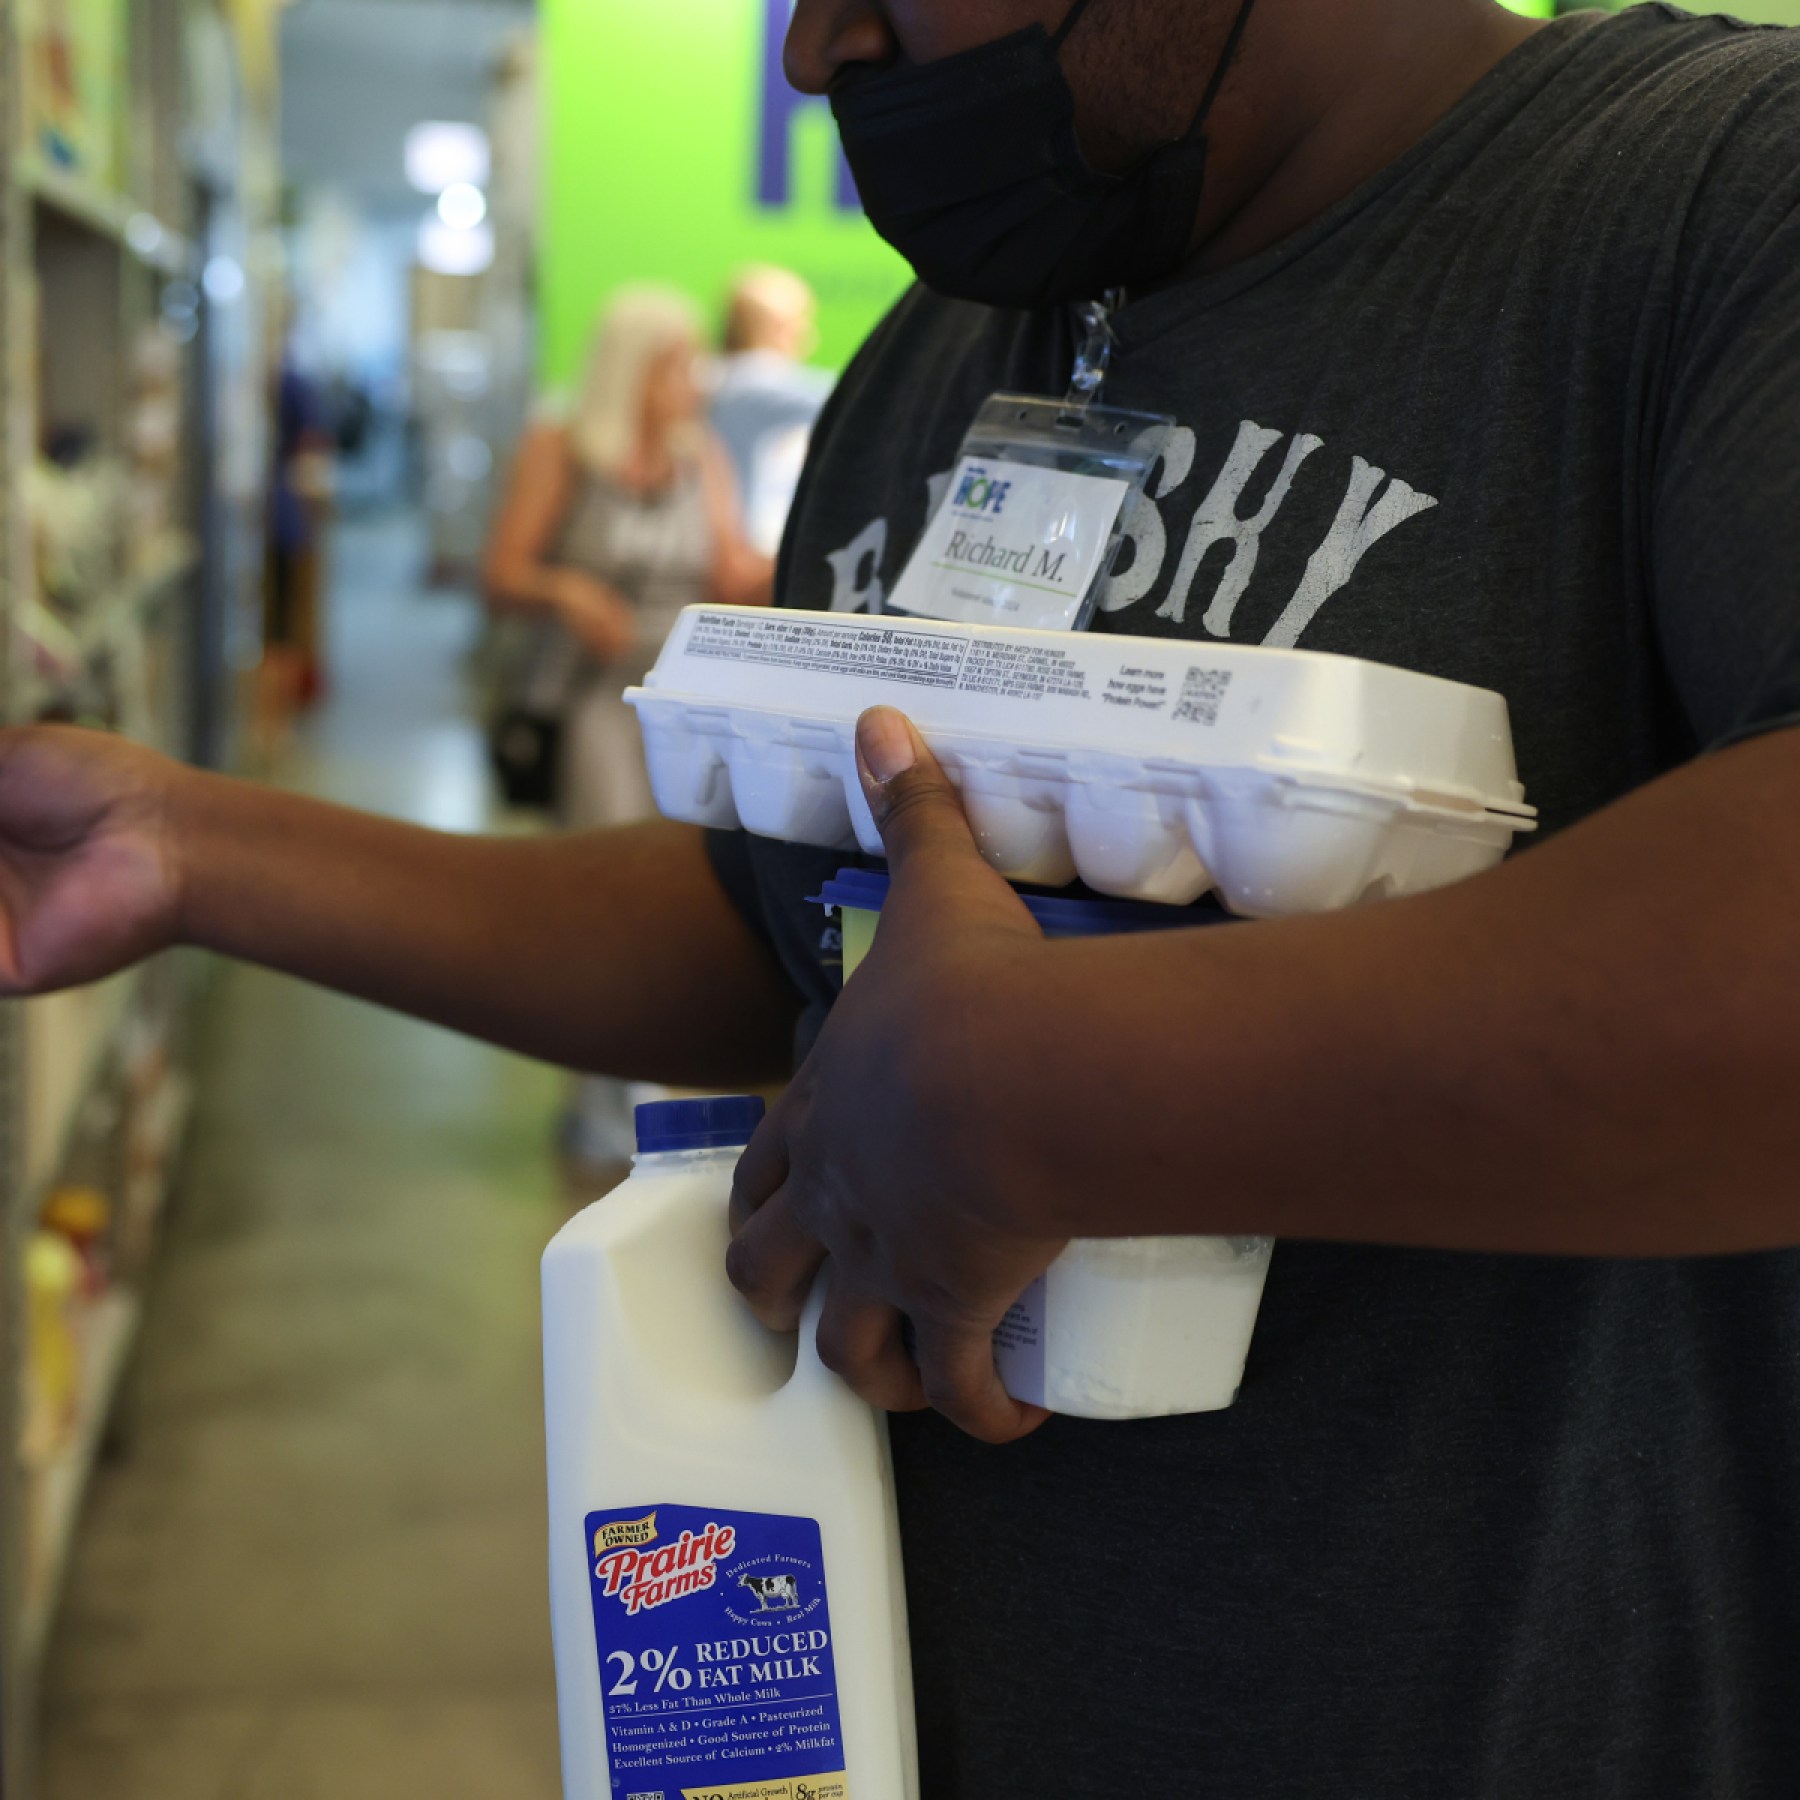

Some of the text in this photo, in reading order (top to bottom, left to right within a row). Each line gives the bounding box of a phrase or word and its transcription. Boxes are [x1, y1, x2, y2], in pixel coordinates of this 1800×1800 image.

[945, 530, 1066, 583] Richard M.
[858, 631, 880, 642] Calories
[1119, 664, 1164, 679] Learn more
[602, 1520, 650, 1540] FARMER
[605, 1532, 649, 1547] OWNED
[597, 1523, 735, 1595] Prairie
[725, 1553, 811, 1578] Dedicated Farmers
[620, 1563, 716, 1614] Farms
[725, 1598, 821, 1626] Happy Cows Real Milk
[695, 1629, 828, 1663] REDUCED
[606, 1645, 693, 1696] 2%
[698, 1655, 822, 1688] FAT MILK
[609, 1688, 781, 1714] 37% Less Fat Than Whole Milk
[611, 1705, 824, 1738] Vitamin A & D Grade A Pasteurized
[612, 1722, 831, 1755] Homogenized Good Source of Protein
[614, 1736, 836, 1769] Excellent Source of Calcium 2% Milkfat
[760, 1786, 788, 1798] Growth
